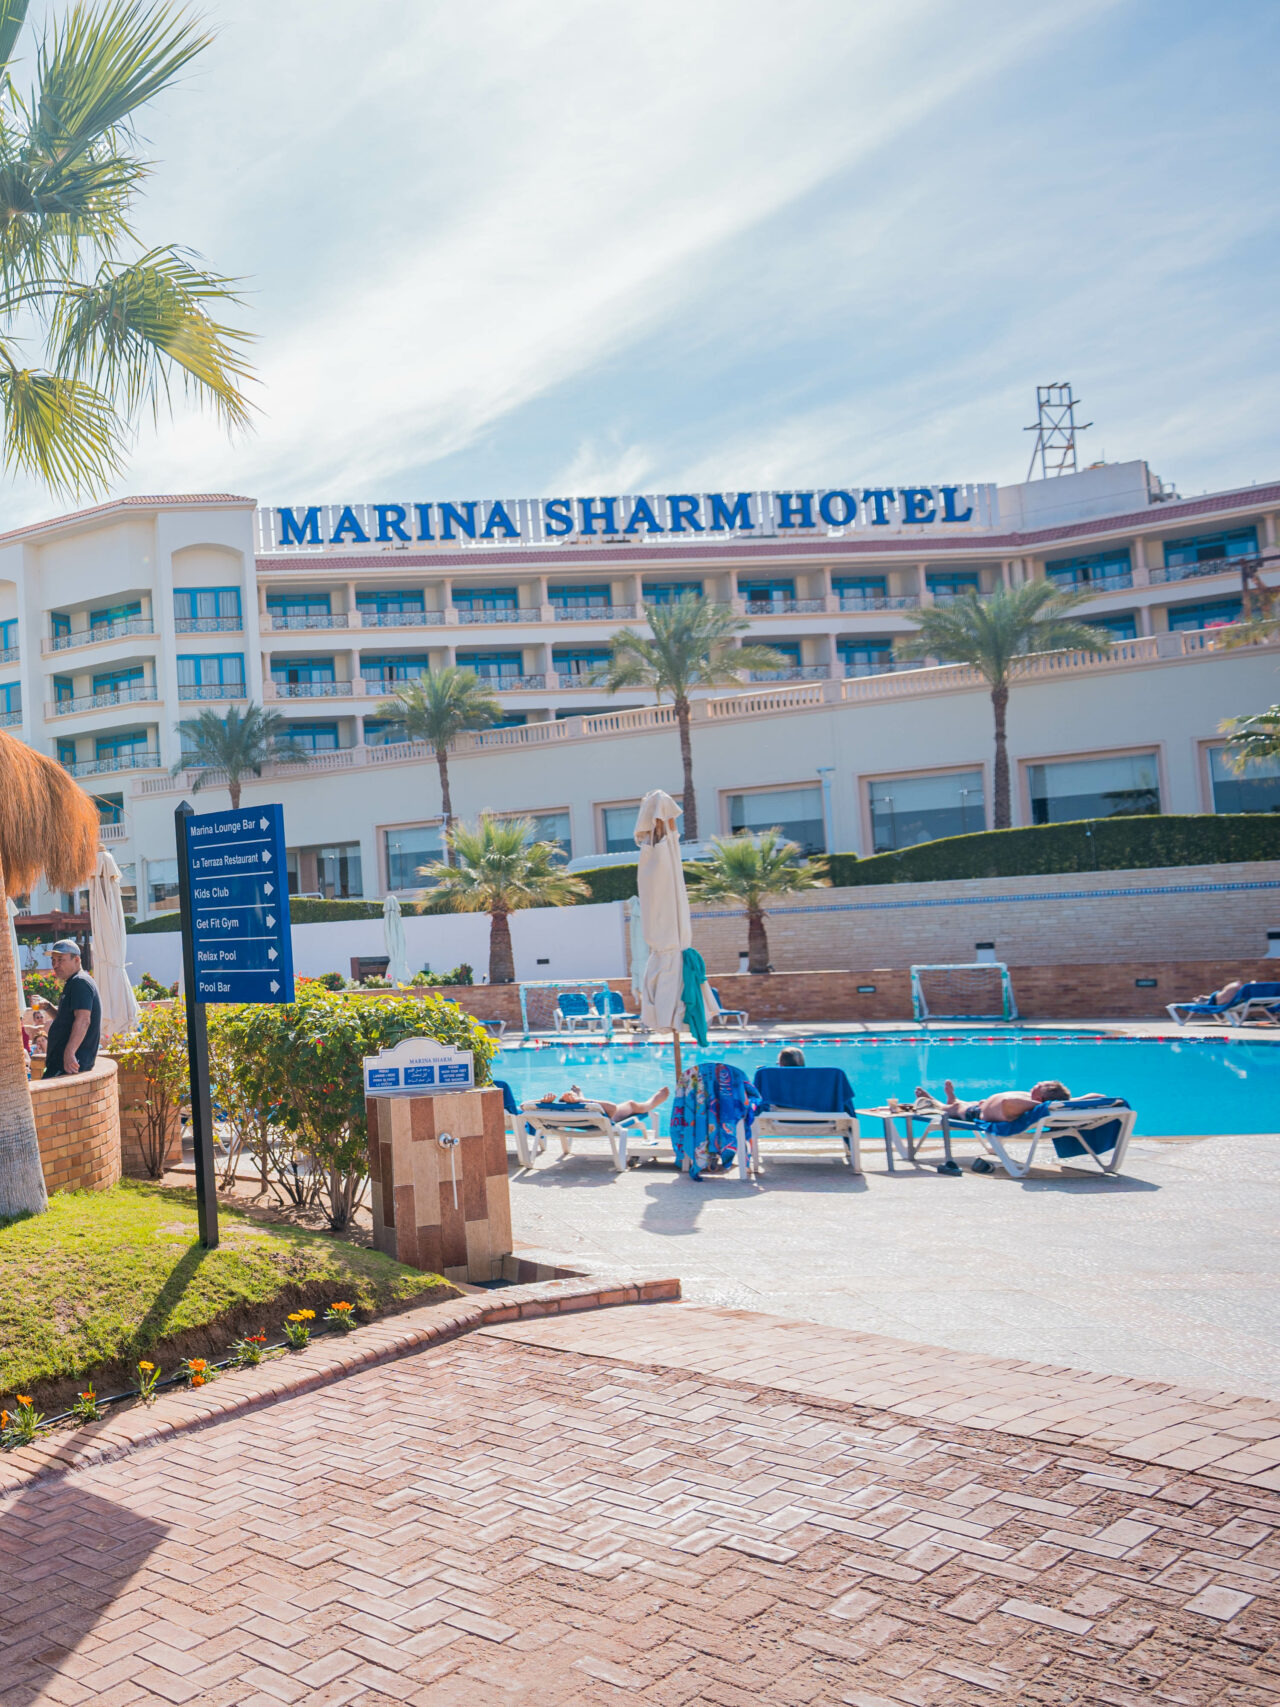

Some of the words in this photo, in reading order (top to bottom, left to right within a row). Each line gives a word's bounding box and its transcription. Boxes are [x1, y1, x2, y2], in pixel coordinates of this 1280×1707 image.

[277, 501, 521, 545] MARINA
[545, 493, 755, 536] SHARM
[776, 488, 973, 529] HOTEL
[190, 826, 213, 837] Marina
[214, 823, 241, 835] Lounge
[243, 819, 256, 830] Bar
[192, 859, 200, 869] La
[201, 857, 223, 868] Terraza
[224, 853, 259, 866] Restaurant
[194, 889, 210, 899] Kids
[211, 887, 229, 898] Club
[196, 919, 209, 929] Get
[210, 918, 221, 928] Fit
[221, 917, 239, 930] Gym
[197, 951, 218, 961] Relax
[219, 950, 237, 961] Pool
[199, 982, 216, 992] Pool
[217, 982, 231, 992] Bar
